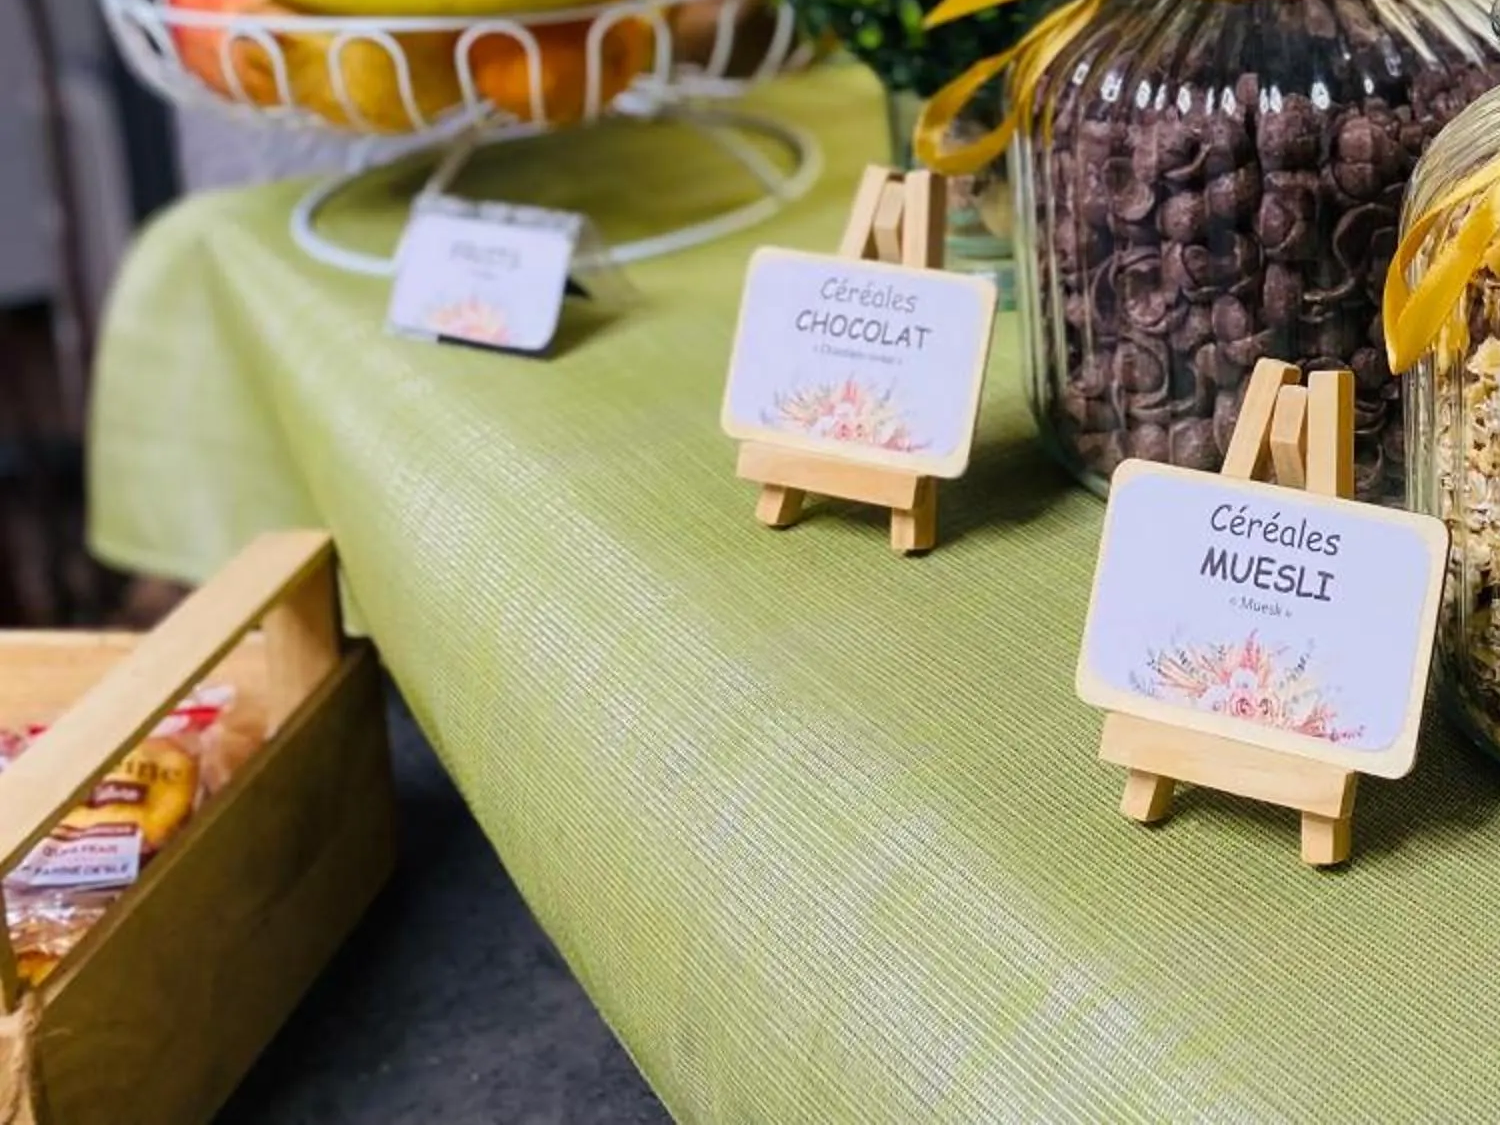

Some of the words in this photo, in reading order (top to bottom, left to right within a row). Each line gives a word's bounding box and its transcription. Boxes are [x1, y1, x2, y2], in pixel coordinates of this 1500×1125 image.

[820, 277, 918, 313] Céréales
[795, 309, 933, 349] CHOCOLAT
[1210, 503, 1341, 556] Céréales
[1200, 546, 1335, 602] MUESLI
